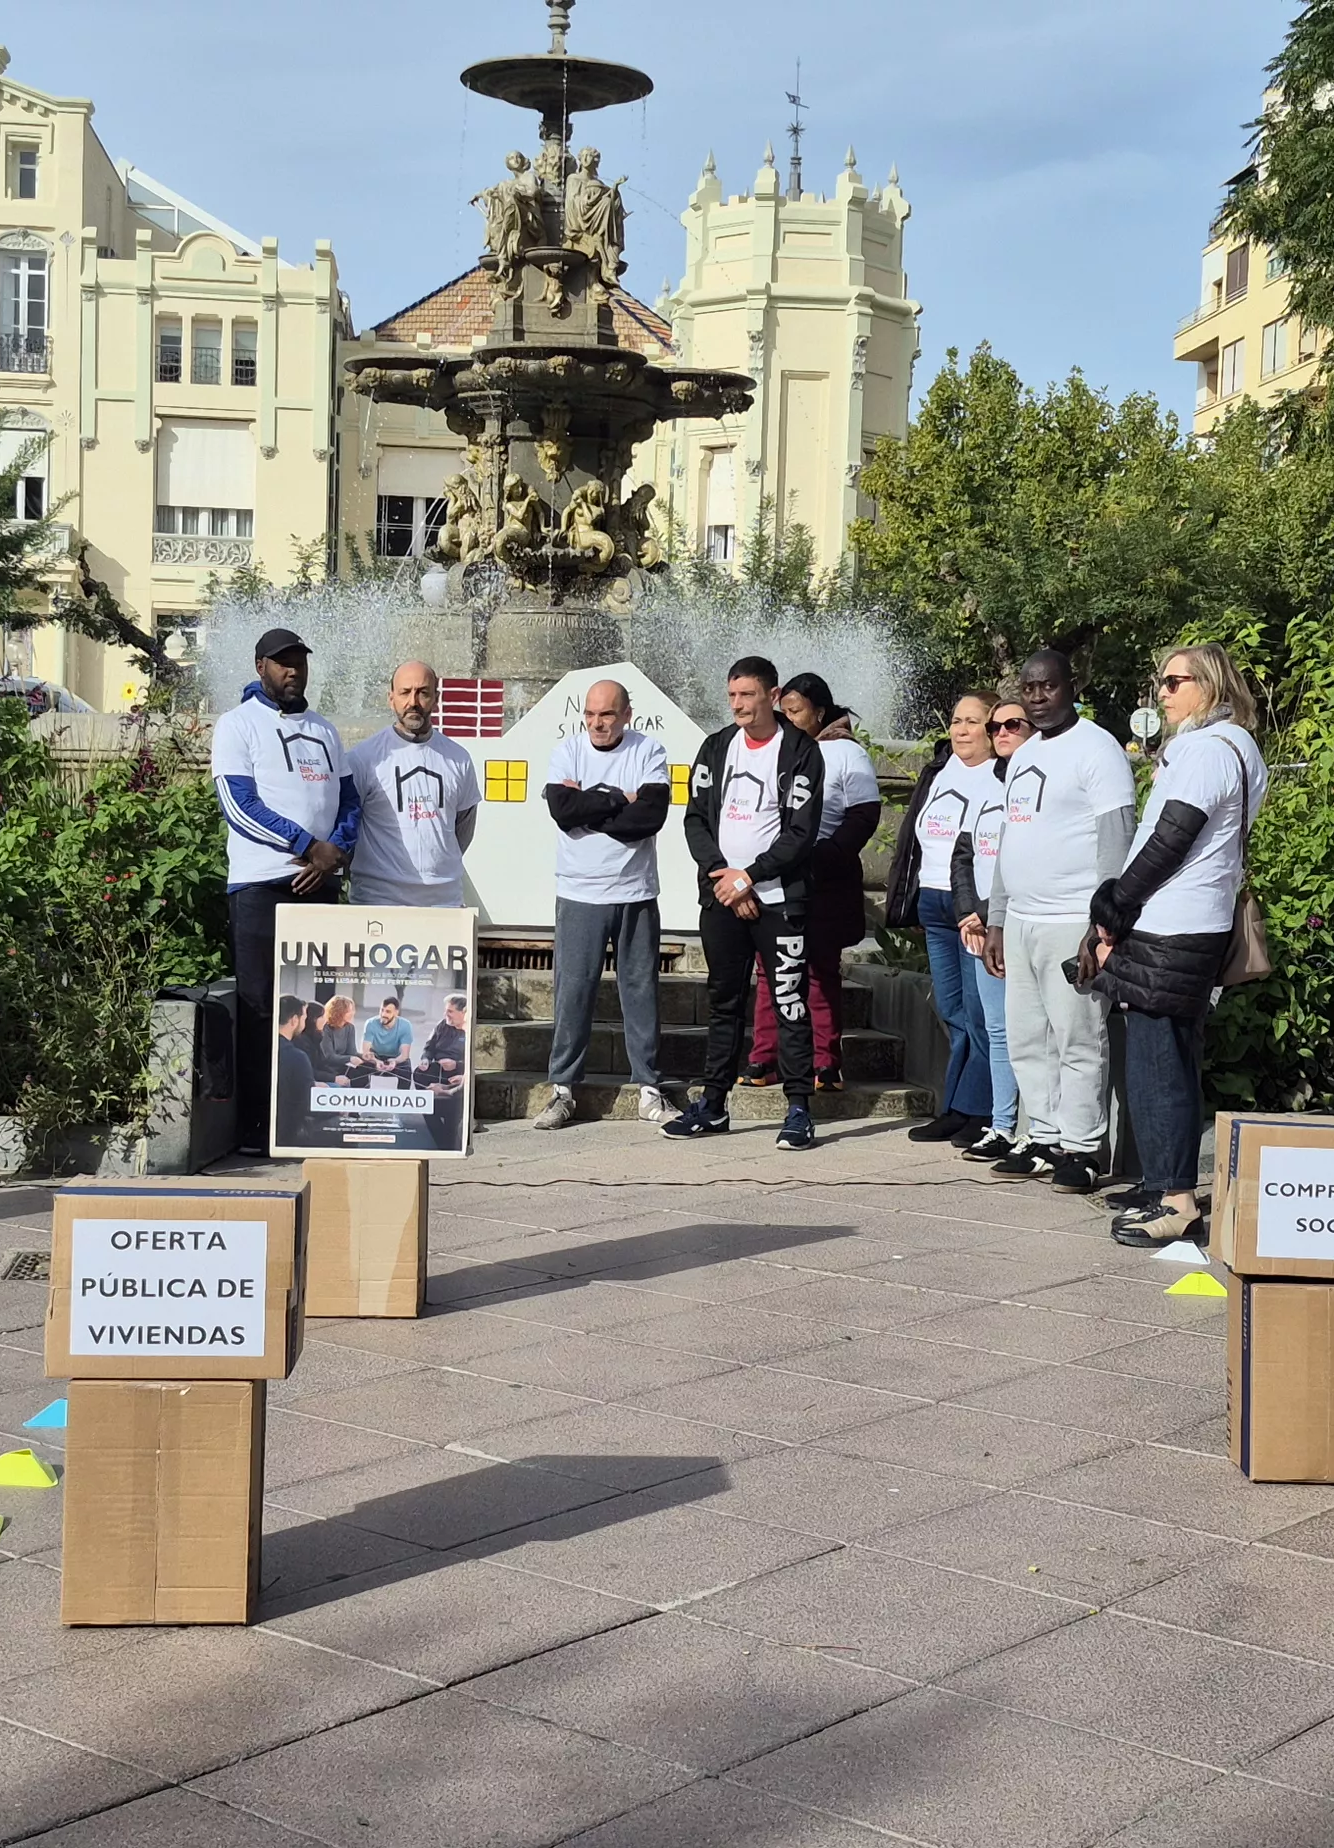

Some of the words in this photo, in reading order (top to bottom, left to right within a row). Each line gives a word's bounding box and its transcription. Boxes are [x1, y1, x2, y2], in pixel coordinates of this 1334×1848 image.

[301, 773, 331, 781] HOGAR
[408, 794, 432, 803] NADIE
[281, 941, 329, 967] UN
[344, 942, 468, 970] HOGAR
[775, 935, 806, 1020] PARIS
[316, 1094, 427, 1108] COMUNIDAD
[111, 1230, 227, 1251] OFERTA
[81, 1272, 208, 1298] PÚBLICA
[217, 1278, 255, 1299] DE
[88, 1325, 246, 1346] VIVIENDAS
